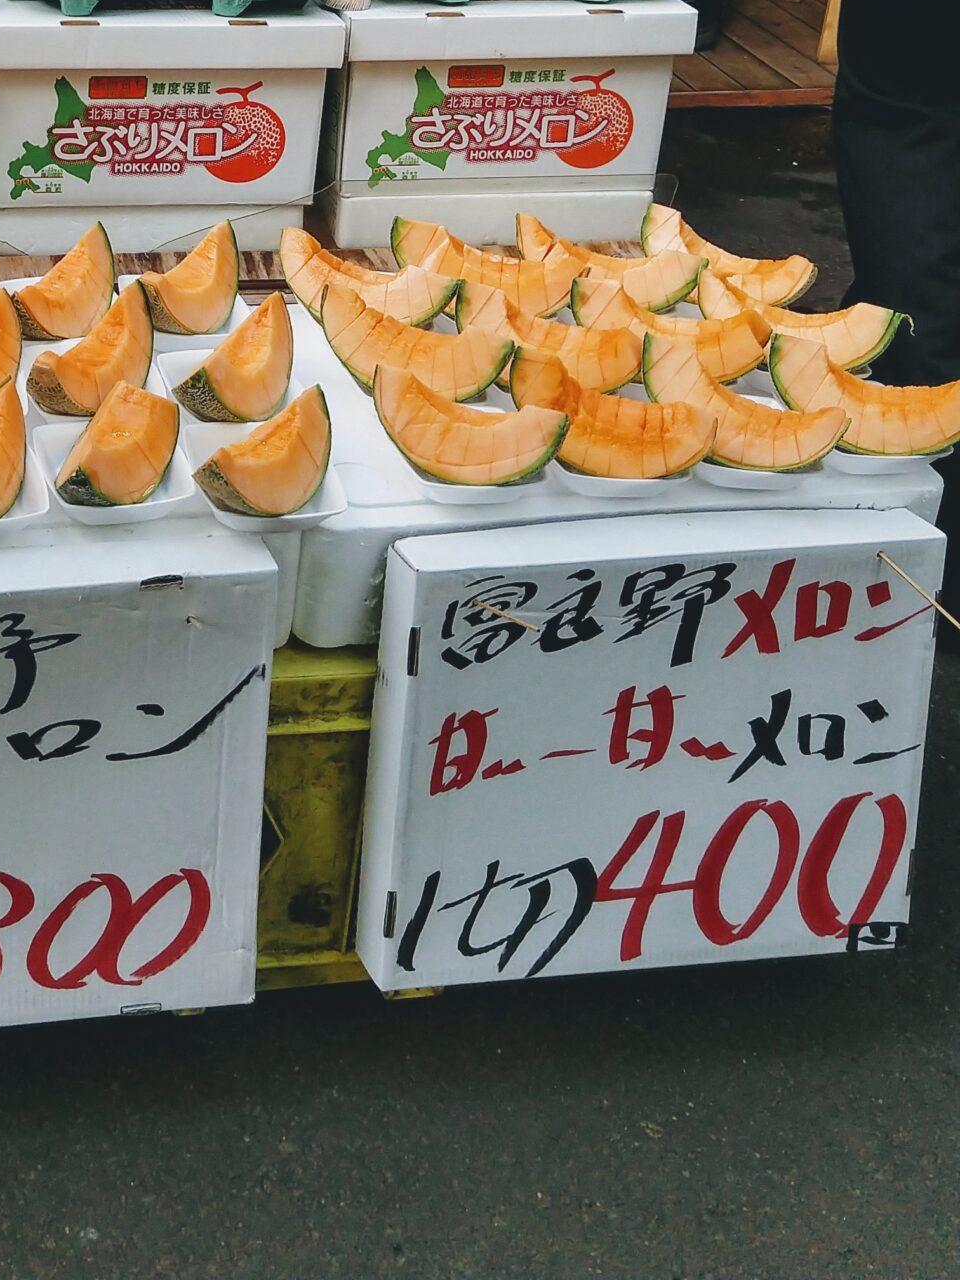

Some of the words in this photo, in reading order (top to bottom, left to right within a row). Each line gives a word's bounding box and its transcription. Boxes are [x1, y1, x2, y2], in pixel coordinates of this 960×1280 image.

[509, 69, 567, 83] 糖度保証
[151, 82, 211, 95] 糖度保証
[447, 94, 578, 109] 北海道で育った美味しさ
[88, 106, 224, 121] 北海道で育った美味しさ
[411, 107, 609, 148] さぶりメロン
[51, 119, 258, 162] さぶりメロン
[469, 149, 534, 161] HOKKAIDO
[114, 162, 181, 174] HOKKAIDO
[594, 791, 908, 962] 400
